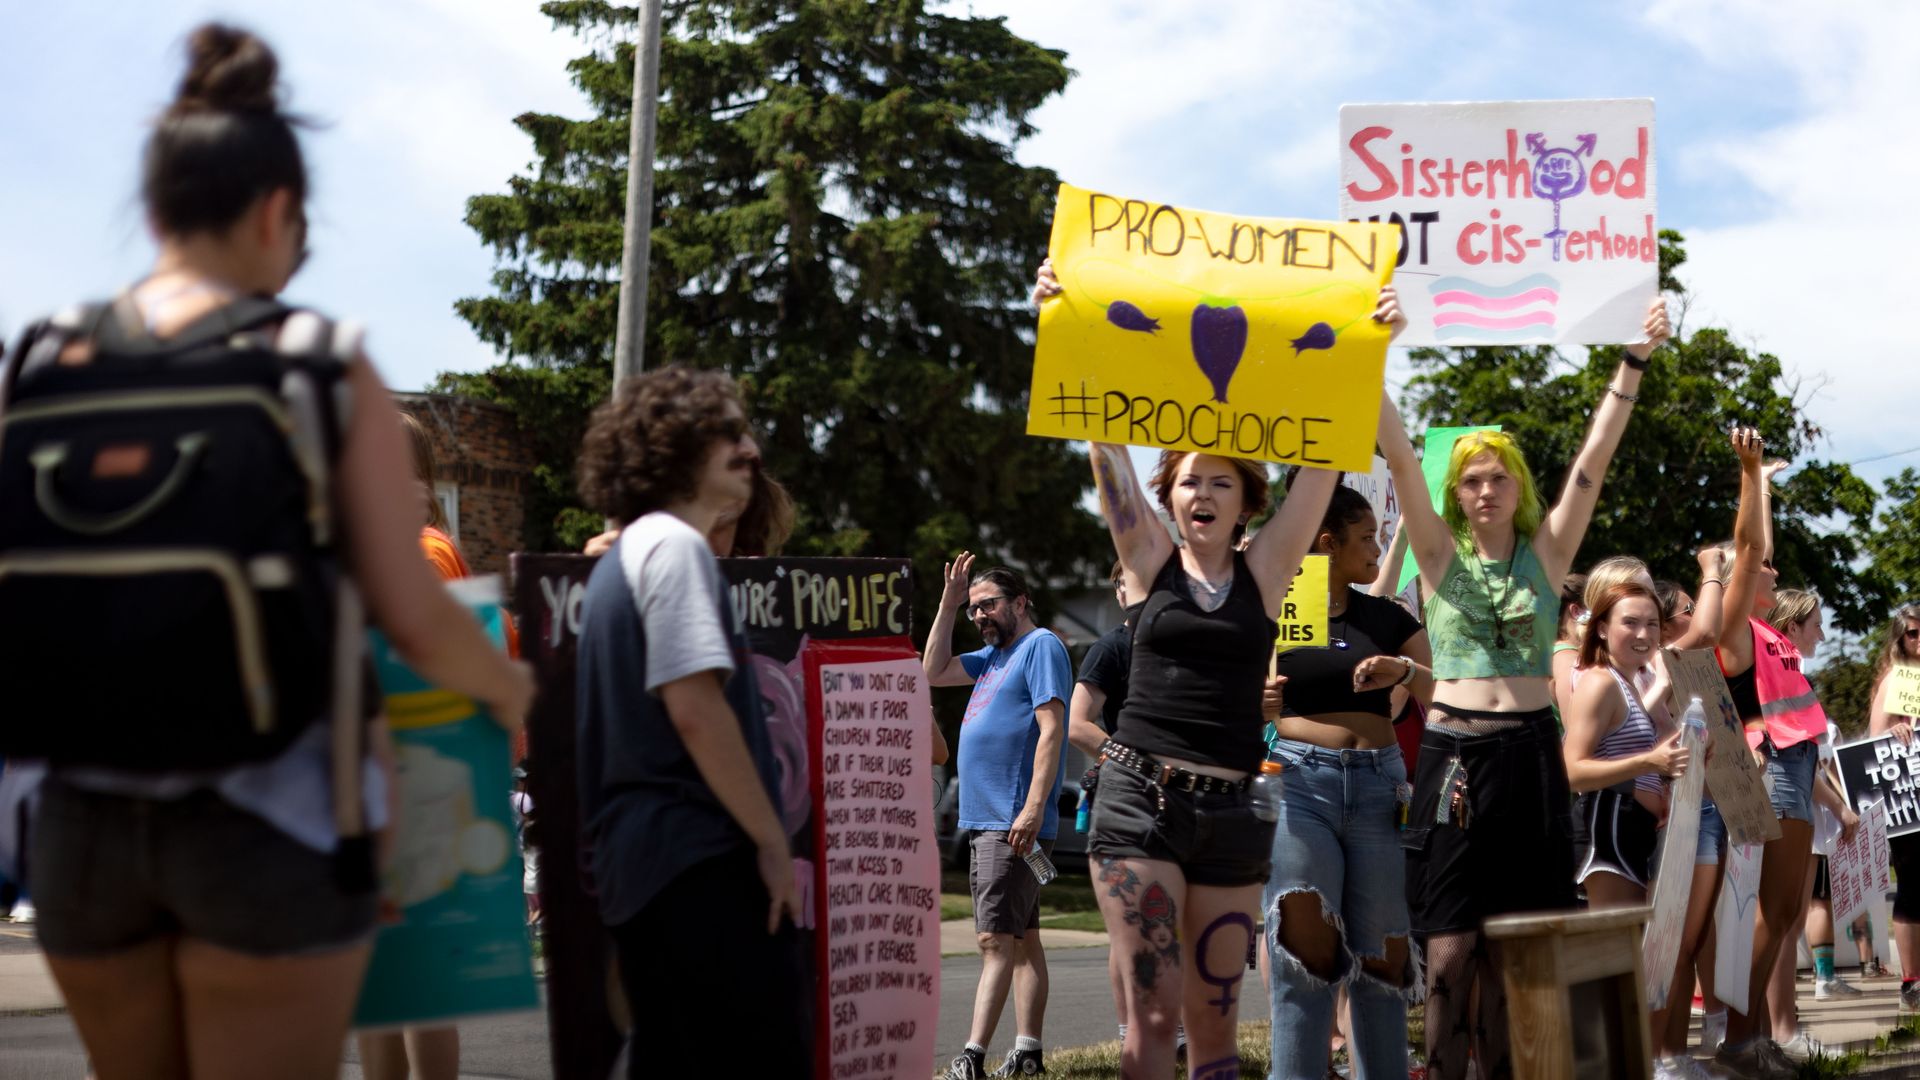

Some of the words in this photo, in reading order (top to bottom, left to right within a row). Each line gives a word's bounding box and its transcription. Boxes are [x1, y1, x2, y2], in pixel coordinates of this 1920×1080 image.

[1089, 193, 1377, 273] PRO-WOMEN
[1348, 210, 1440, 268] OT
[1048, 381, 1333, 464] #PROCHOICE
[823, 670, 844, 694] BUT
[848, 672, 864, 691] YOU
[897, 673, 917, 694] GIVE
[825, 700, 832, 721] A
[835, 700, 864, 721] DAMN
[870, 701, 878, 720] IF
[882, 700, 908, 720] POOR
[825, 727, 870, 746] CHILDREN
[876, 727, 913, 750] STARVE
[825, 753, 840, 775] OR
[845, 753, 854, 772] IF
[859, 754, 884, 773] THEIR
[888, 756, 912, 777] LIVES
[1865, 764, 1900, 785] TO
[824, 780, 845, 800] ARE
[851, 778, 905, 801] SHATTERED
[824, 808, 849, 826] WHEN
[881, 806, 917, 829] MOTHERS
[825, 832, 840, 851] DIE
[845, 831, 879, 848] BECAUSE
[882, 832, 896, 850] YOU
[827, 858, 854, 876] THINK
[857, 855, 887, 876] ACCESS
[891, 858, 902, 875] TO
[829, 884, 862, 909] HEALTH
[868, 882, 892, 905] CARE
[897, 884, 934, 911] MATTERS
[830, 917, 847, 938] AND
[851, 914, 865, 935] YOU
[893, 913, 914, 936] GIVE
[916, 918, 923, 937] A
[831, 943, 859, 971] DAMN
[865, 941, 874, 963] IF
[878, 940, 917, 964] REFUGEE
[831, 972, 872, 997] CHILDREN
[876, 971, 904, 991] DROWN
[907, 973, 916, 990] IN
[918, 972, 933, 995] THE
[833, 1001, 858, 1029] SEA
[833, 1033, 847, 1055] OR
[851, 1029, 860, 1051] IF
[864, 1024, 882, 1048] 3RD
[887, 1021, 916, 1042] WORLD
